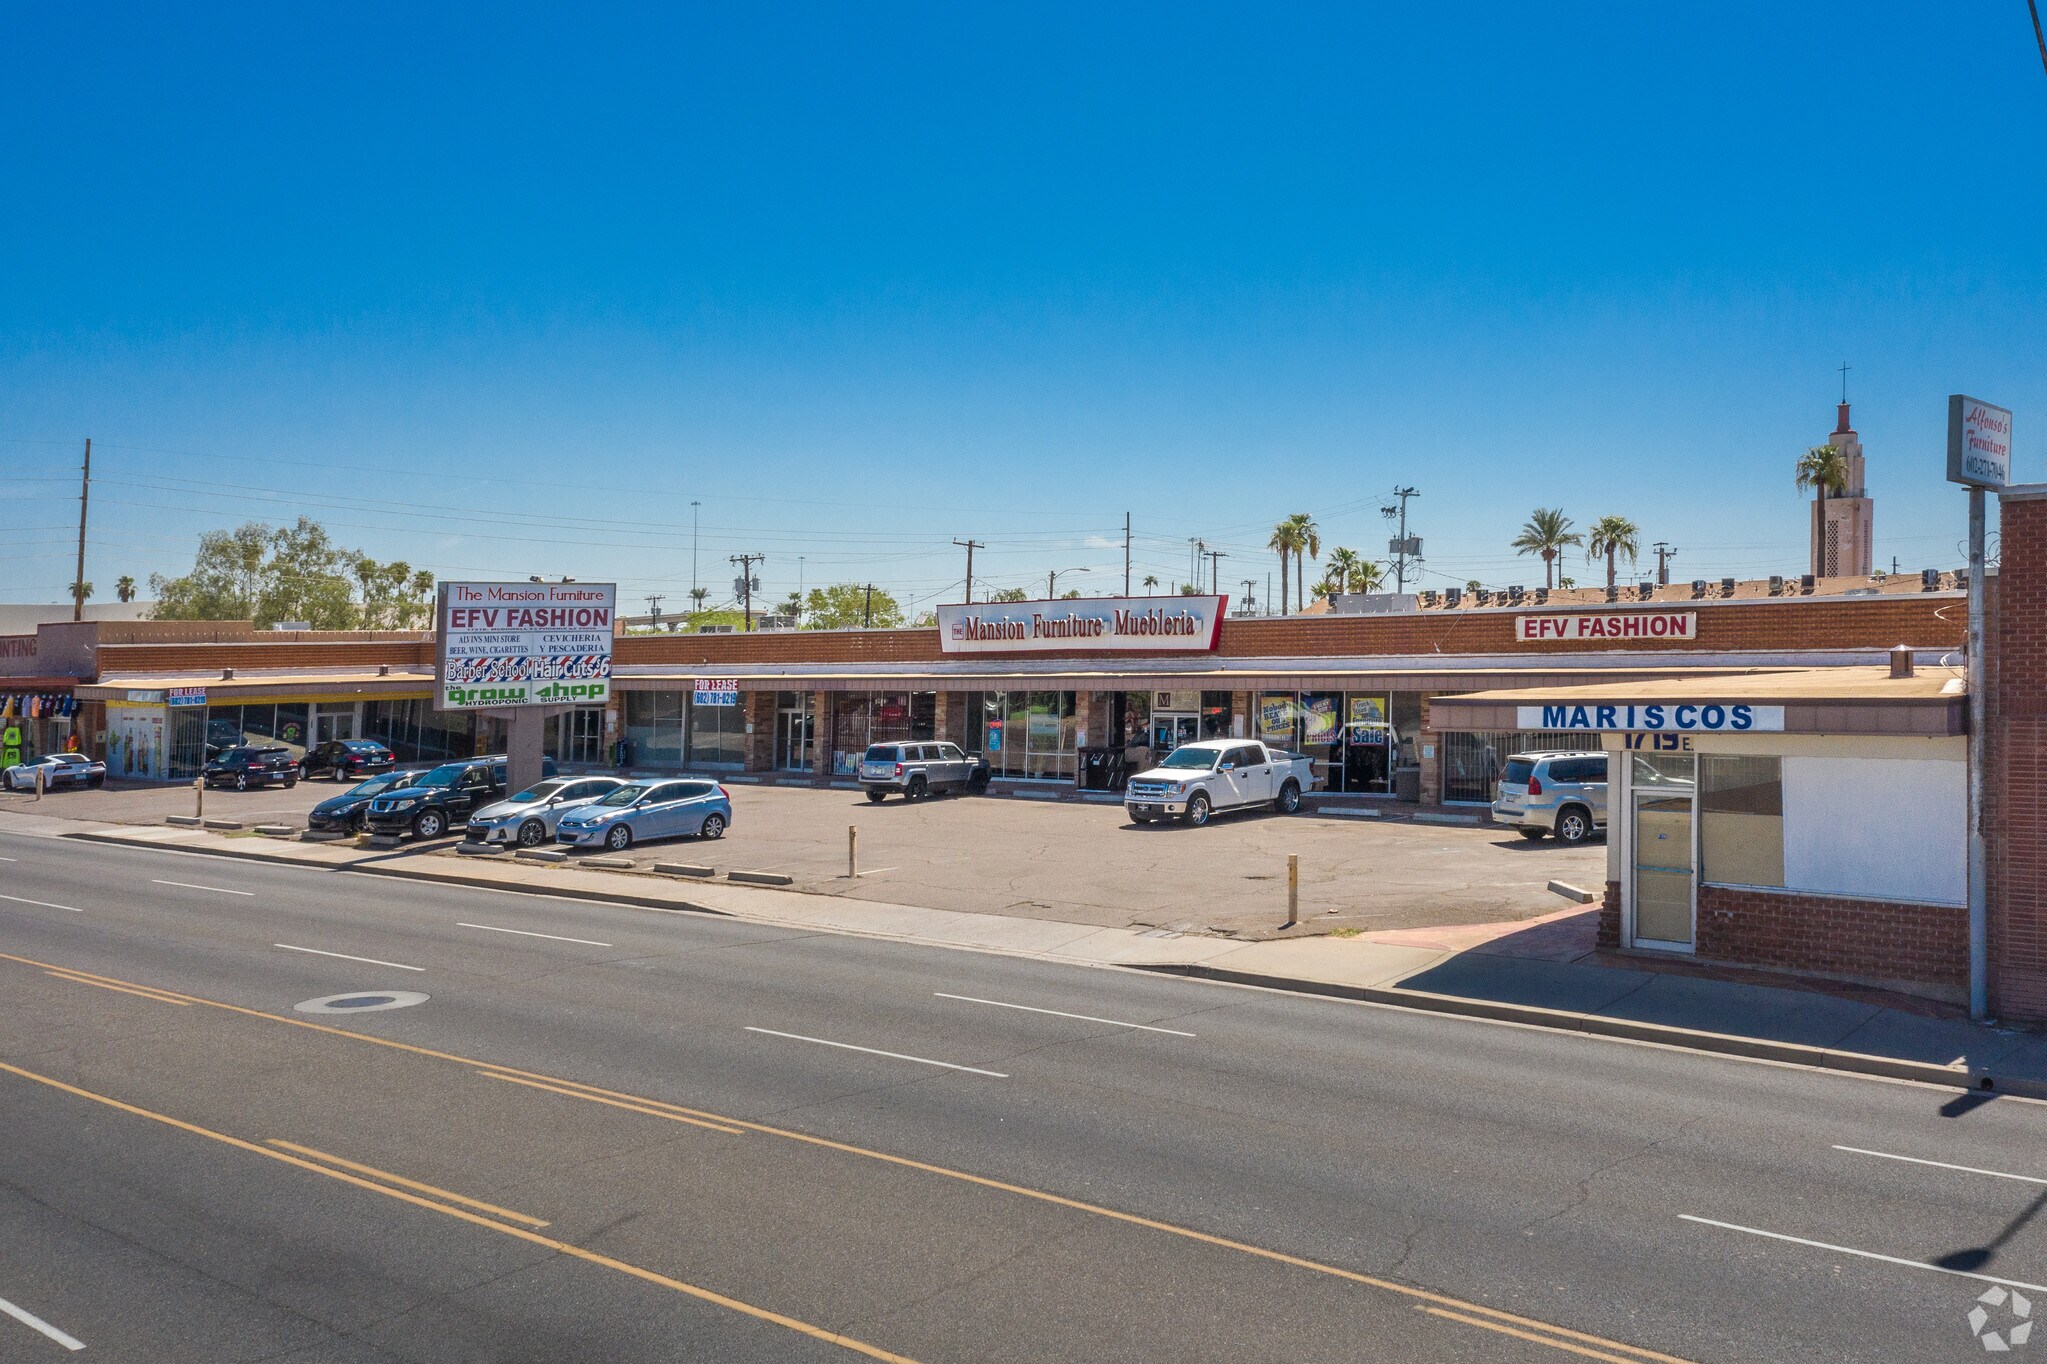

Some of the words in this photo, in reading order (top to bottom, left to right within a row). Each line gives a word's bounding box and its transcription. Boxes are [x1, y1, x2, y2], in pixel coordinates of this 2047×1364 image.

[1966, 407, 2008, 434] Alfonso's
[1966, 429, 2006, 456] Furniture
[456, 586, 482, 601] The
[488, 586, 544, 601] Mansion
[550, 586, 604, 601] Furniture
[451, 608, 499, 627] EFV
[506, 608, 608, 627] FASHION
[966, 616, 1025, 640] Mansion
[1032, 613, 1104, 639] Furniture
[1114, 608, 1196, 636] Muebleria
[1524, 618, 1568, 639] EFV
[1577, 615, 1688, 638] FASHION
[458, 635, 482, 643] ALVIN'S
[484, 635, 500, 643] MINI
[500, 635, 520, 643] STORE
[543, 634, 601, 643] CEVICHERIA
[450, 647, 468, 655] BEER,
[469, 646, 488, 654] WINE,
[490, 646, 528, 654] CIGARETTES
[540, 645, 546, 653] Y
[548, 644, 604, 652] PESCADERIA
[446, 660, 488, 680] Barber
[491, 658, 531, 679] School
[534, 660, 561, 678] Hair
[563, 660, 594, 678] Cuts
[170, 688, 183, 696] FOR
[184, 687, 206, 696] LEASE
[694, 680, 710, 690] FOR
[711, 679, 738, 690] LEASE
[449, 688, 525, 705] grow
[534, 682, 604, 699] shop
[1158, 694, 1169, 706] M
[466, 698, 528, 706] HYDROPONIC
[1543, 705, 1752, 730] MARISCOS
[1266, 721, 1290, 732] PRICES
[1353, 726, 1383, 743] Sale
